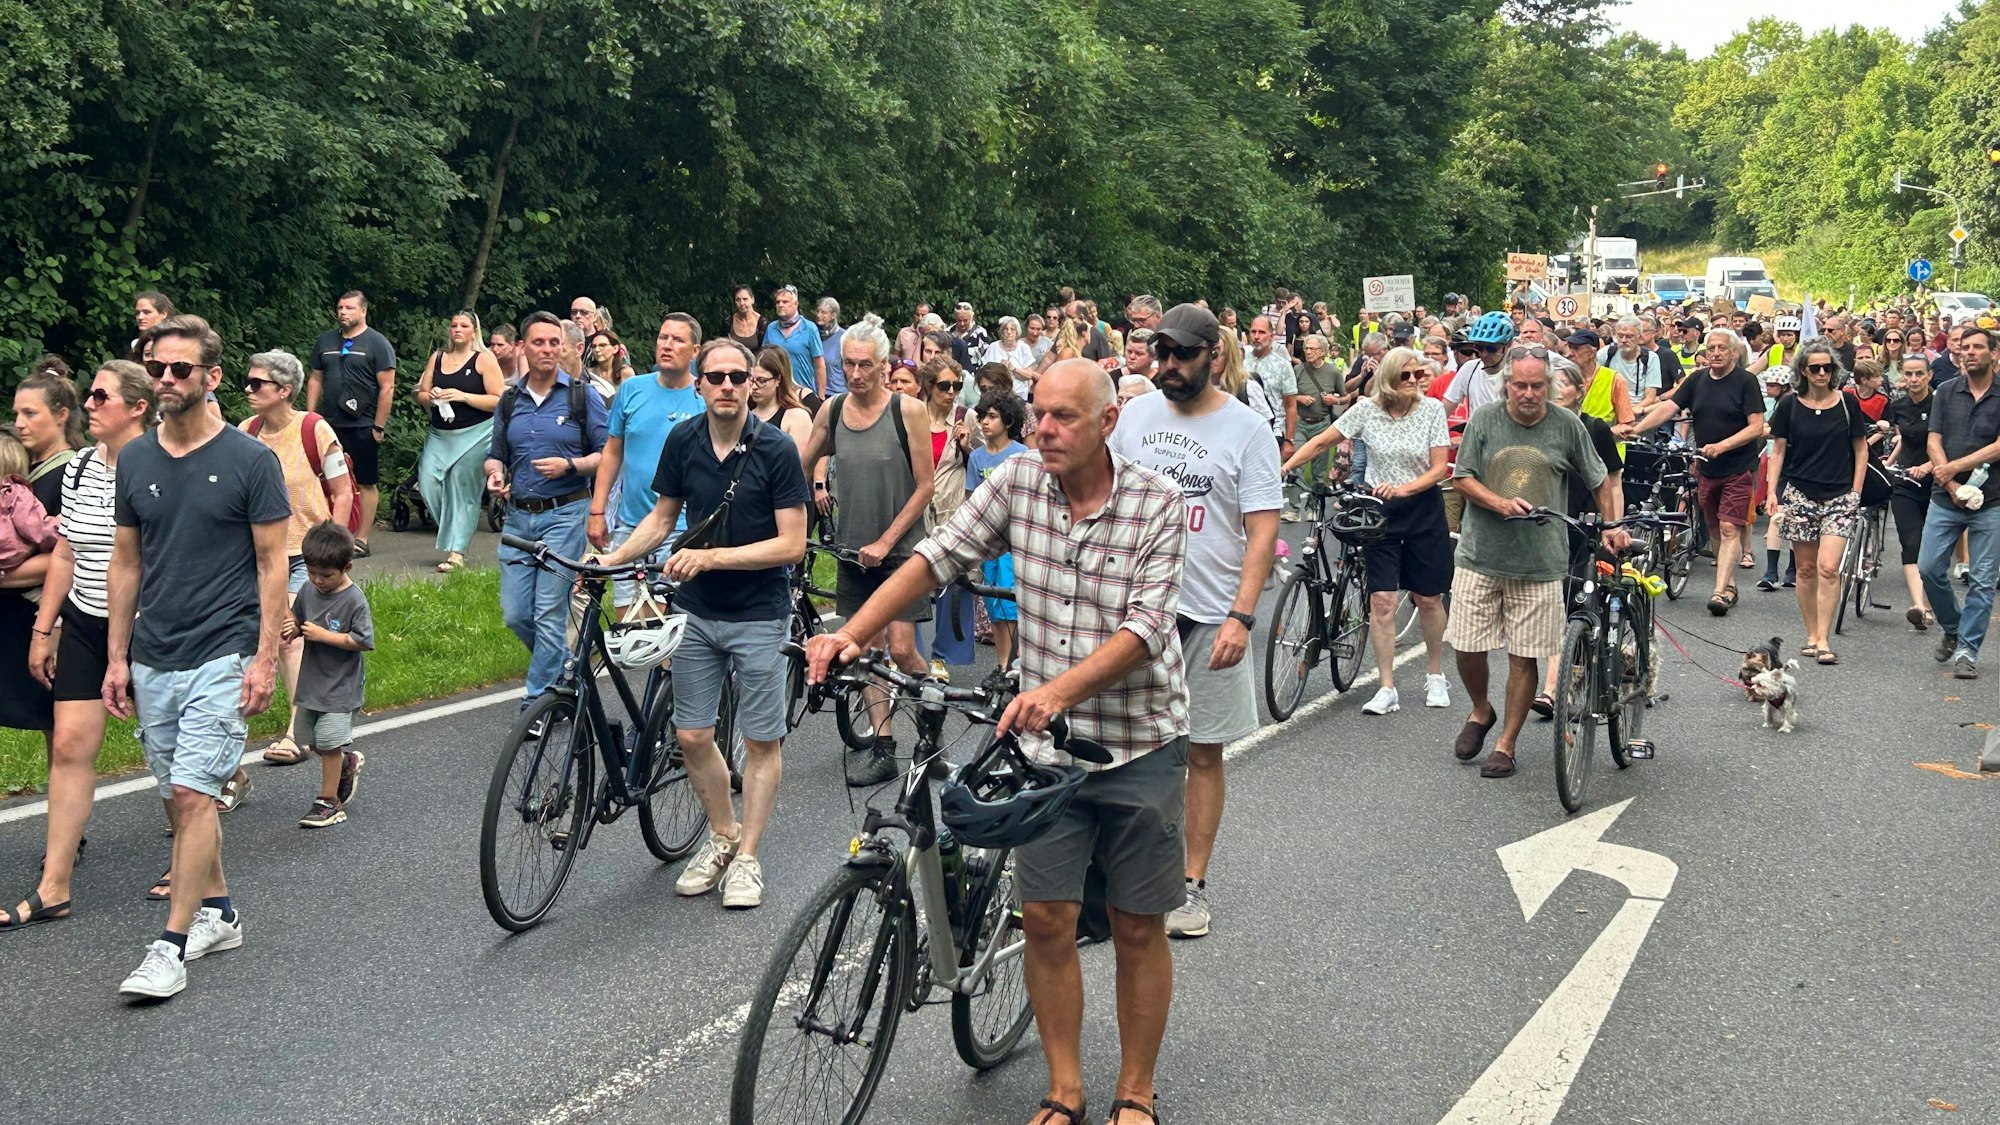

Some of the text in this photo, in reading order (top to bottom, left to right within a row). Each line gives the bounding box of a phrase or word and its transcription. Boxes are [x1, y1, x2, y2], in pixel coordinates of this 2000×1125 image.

[1561, 300, 1574, 316] 30
[1141, 431, 1208, 459] AUTHENTIC
[1186, 504, 1205, 532] 0
